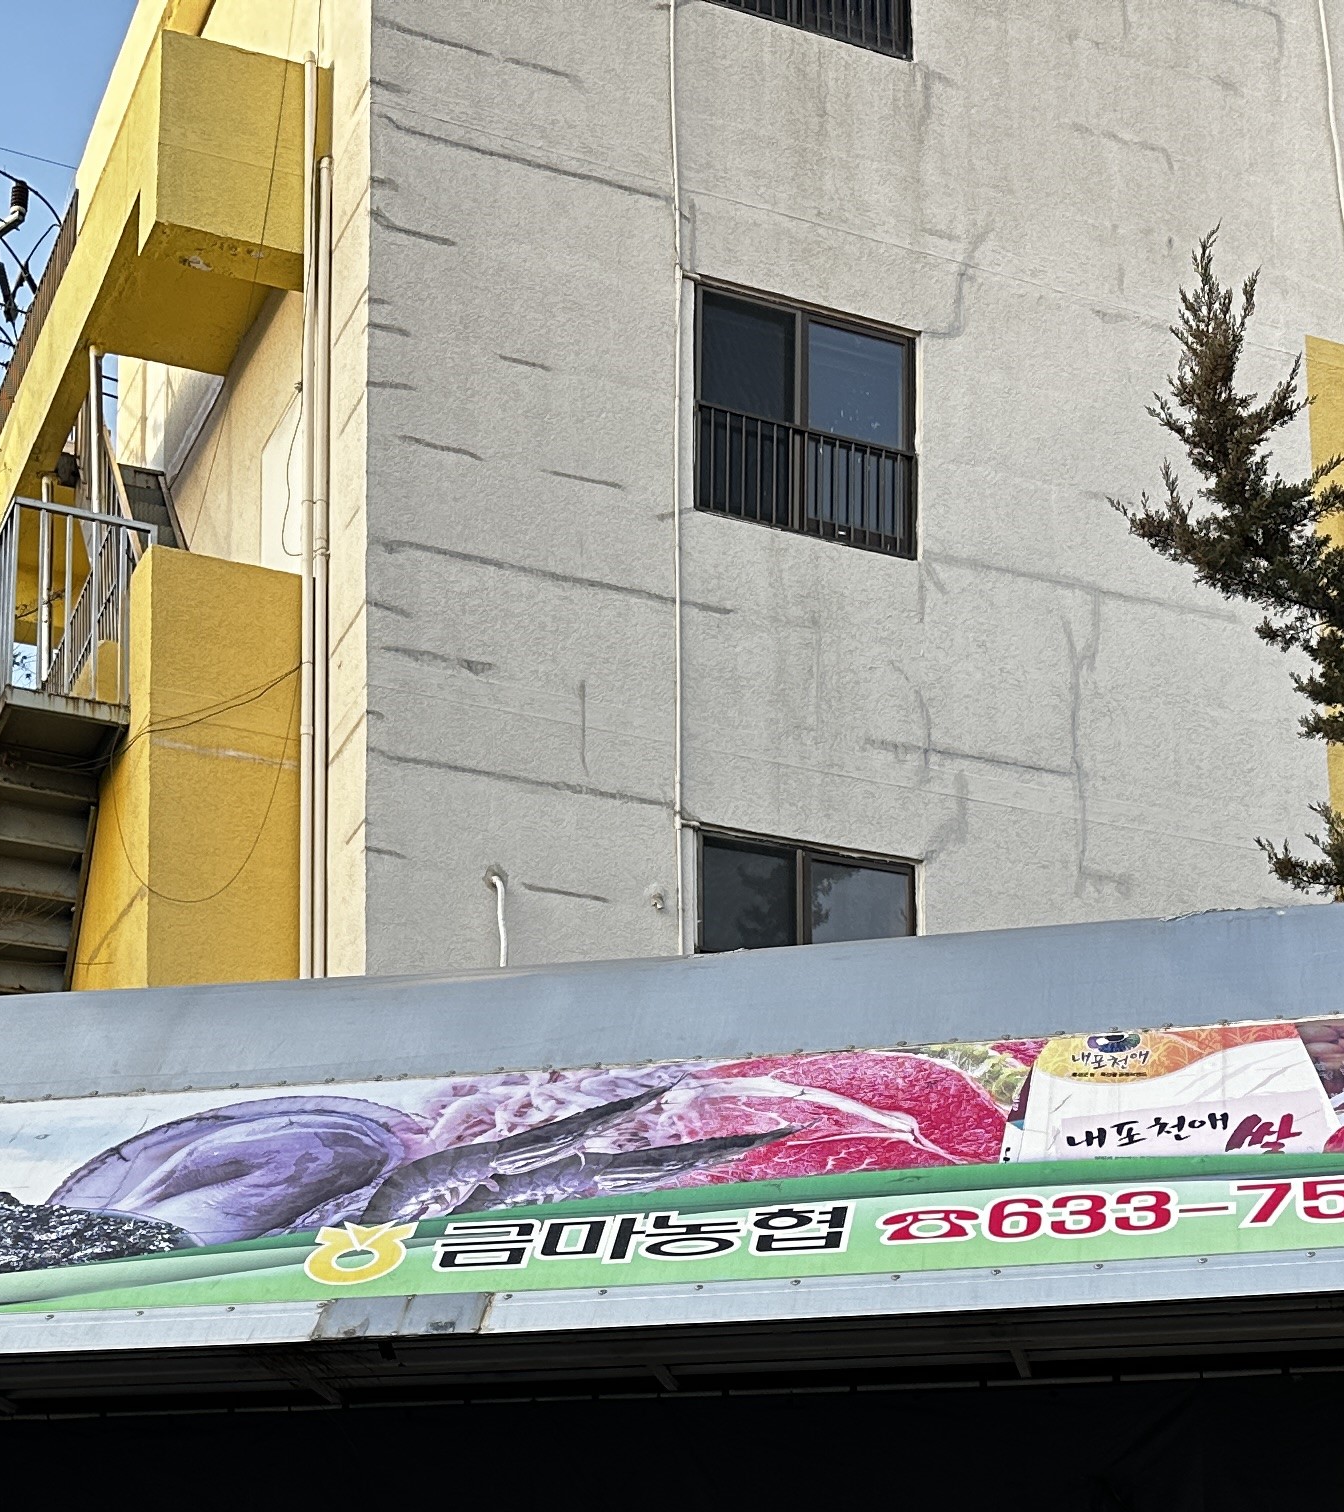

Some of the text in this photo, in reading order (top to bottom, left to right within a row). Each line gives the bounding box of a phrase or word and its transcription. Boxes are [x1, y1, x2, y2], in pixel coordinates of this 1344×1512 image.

[1072, 1050, 1150, 1070] 내포천애
[1066, 1112, 1230, 1148] 내포천애
[435, 1204, 853, 1270] 금마농협
